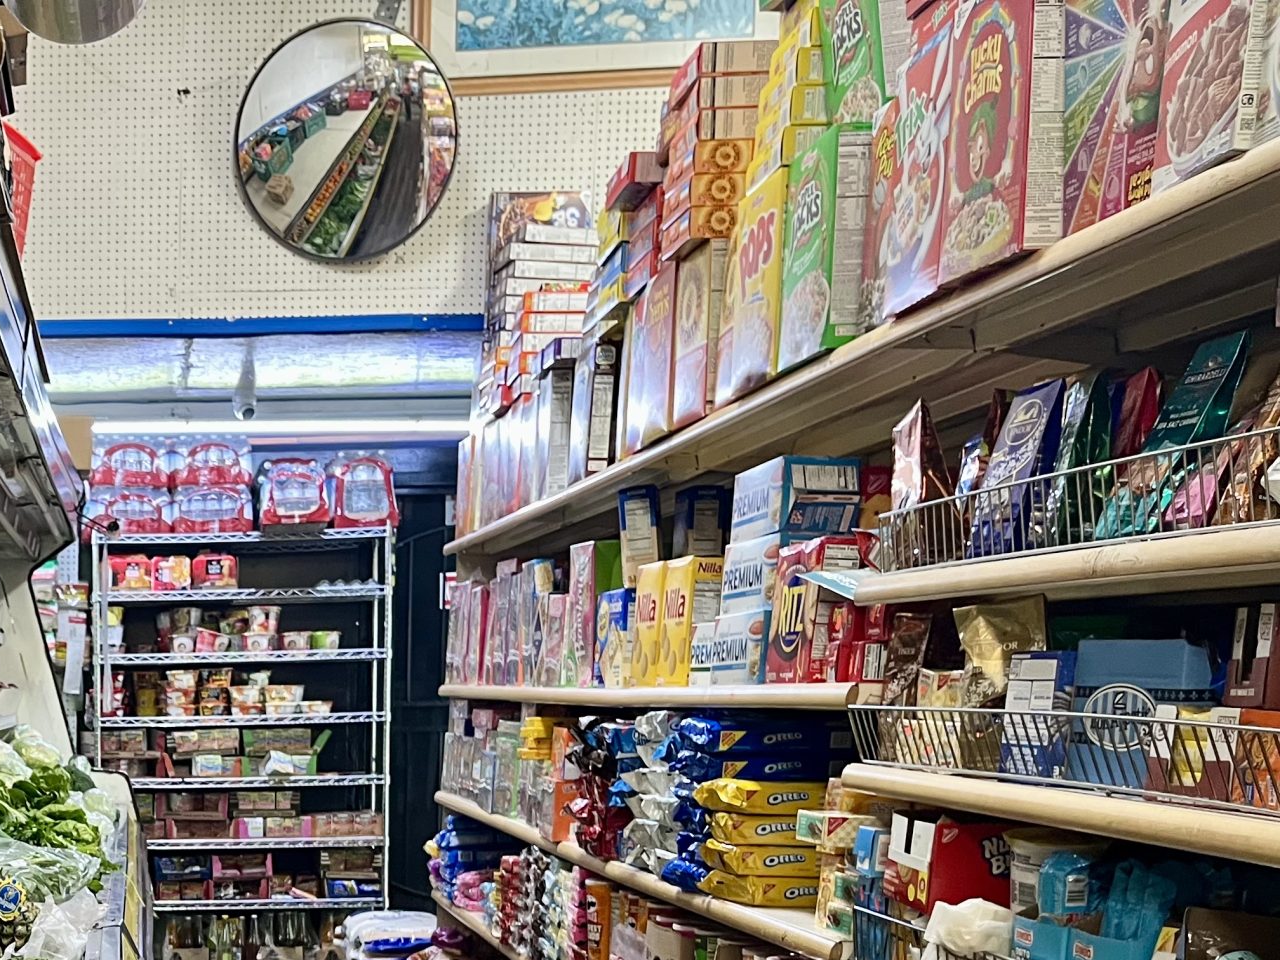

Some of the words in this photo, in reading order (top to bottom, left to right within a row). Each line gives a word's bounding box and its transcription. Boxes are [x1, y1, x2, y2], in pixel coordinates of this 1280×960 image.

[970, 34, 1002, 73] Lucky
[965, 66, 1003, 113] Charms
[896, 89, 927, 164] Trix
[738, 210, 776, 299] POPS
[734, 488, 769, 519] PREMIUM
[698, 561, 722, 574] Nilla
[724, 564, 762, 592] PREMIUM
[637, 593, 656, 624] Nilla
[664, 587, 686, 620] Nilla
[780, 585, 807, 636] RITZ
[711, 638, 747, 663] PREMIUM
[763, 730, 802, 745] OREO
[763, 761, 802, 774] OREO
[766, 791, 810, 806] OREO
[763, 853, 806, 868] OREO
[784, 886, 818, 900] ORE
